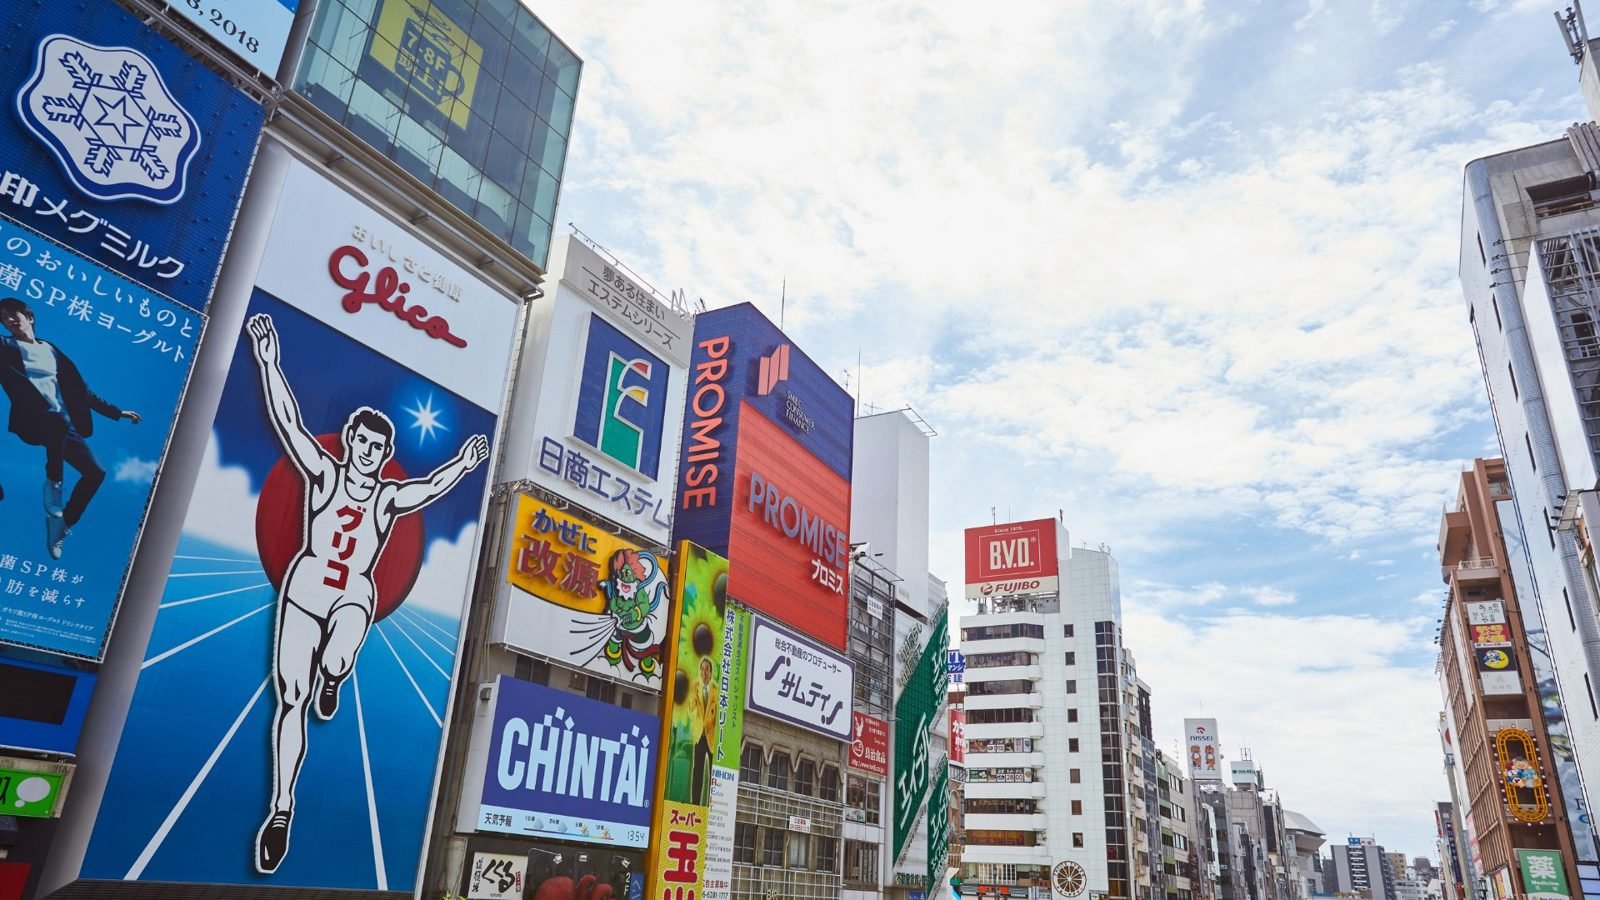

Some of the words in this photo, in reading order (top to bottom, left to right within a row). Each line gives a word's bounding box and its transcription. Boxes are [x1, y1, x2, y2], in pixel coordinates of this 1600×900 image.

[209, 8, 259, 53] 2018
[0, 172, 184, 279] 印メグミルク
[7, 237, 193, 338] のおいしいものと
[352, 225, 463, 303] おいしさと健康
[0, 262, 185, 363] 菌SP株ヨーグルト
[329, 246, 467, 348] Glico
[588, 279, 673, 350] エステムシリーズ
[603, 265, 665, 321] 夢ある住まい
[682, 336, 730, 510] PROMISE
[786, 409, 810, 435] FINANCE
[539, 436, 672, 530] 日商エステム
[323, 505, 366, 591] グリコ
[531, 507, 598, 554] かぜに
[749, 472, 847, 569] PROMISE
[0, 554, 84, 585] 菌SP株が
[517, 534, 601, 600] 改源
[811, 559, 843, 596] プロミス
[990, 538, 1034, 570] B.V.D.
[5, 578, 86, 609] 肪を減らす
[995, 580, 1040, 594] FUJIBO
[775, 638, 841, 673] 総合不動産のプロデューサー
[716, 608, 735, 761] 株式会社日本リート
[778, 672, 831, 711] サムティ
[498, 707, 649, 807] CHINTAI
[712, 769, 735, 781] NIHON
[898, 720, 931, 817] エイブル
[484, 812, 512, 827] 天気予報
[670, 810, 701, 827] スーパー
[481, 859, 515, 893] くくる
[664, 831, 700, 900] 玉
[1526, 856, 1557, 879] 薬
